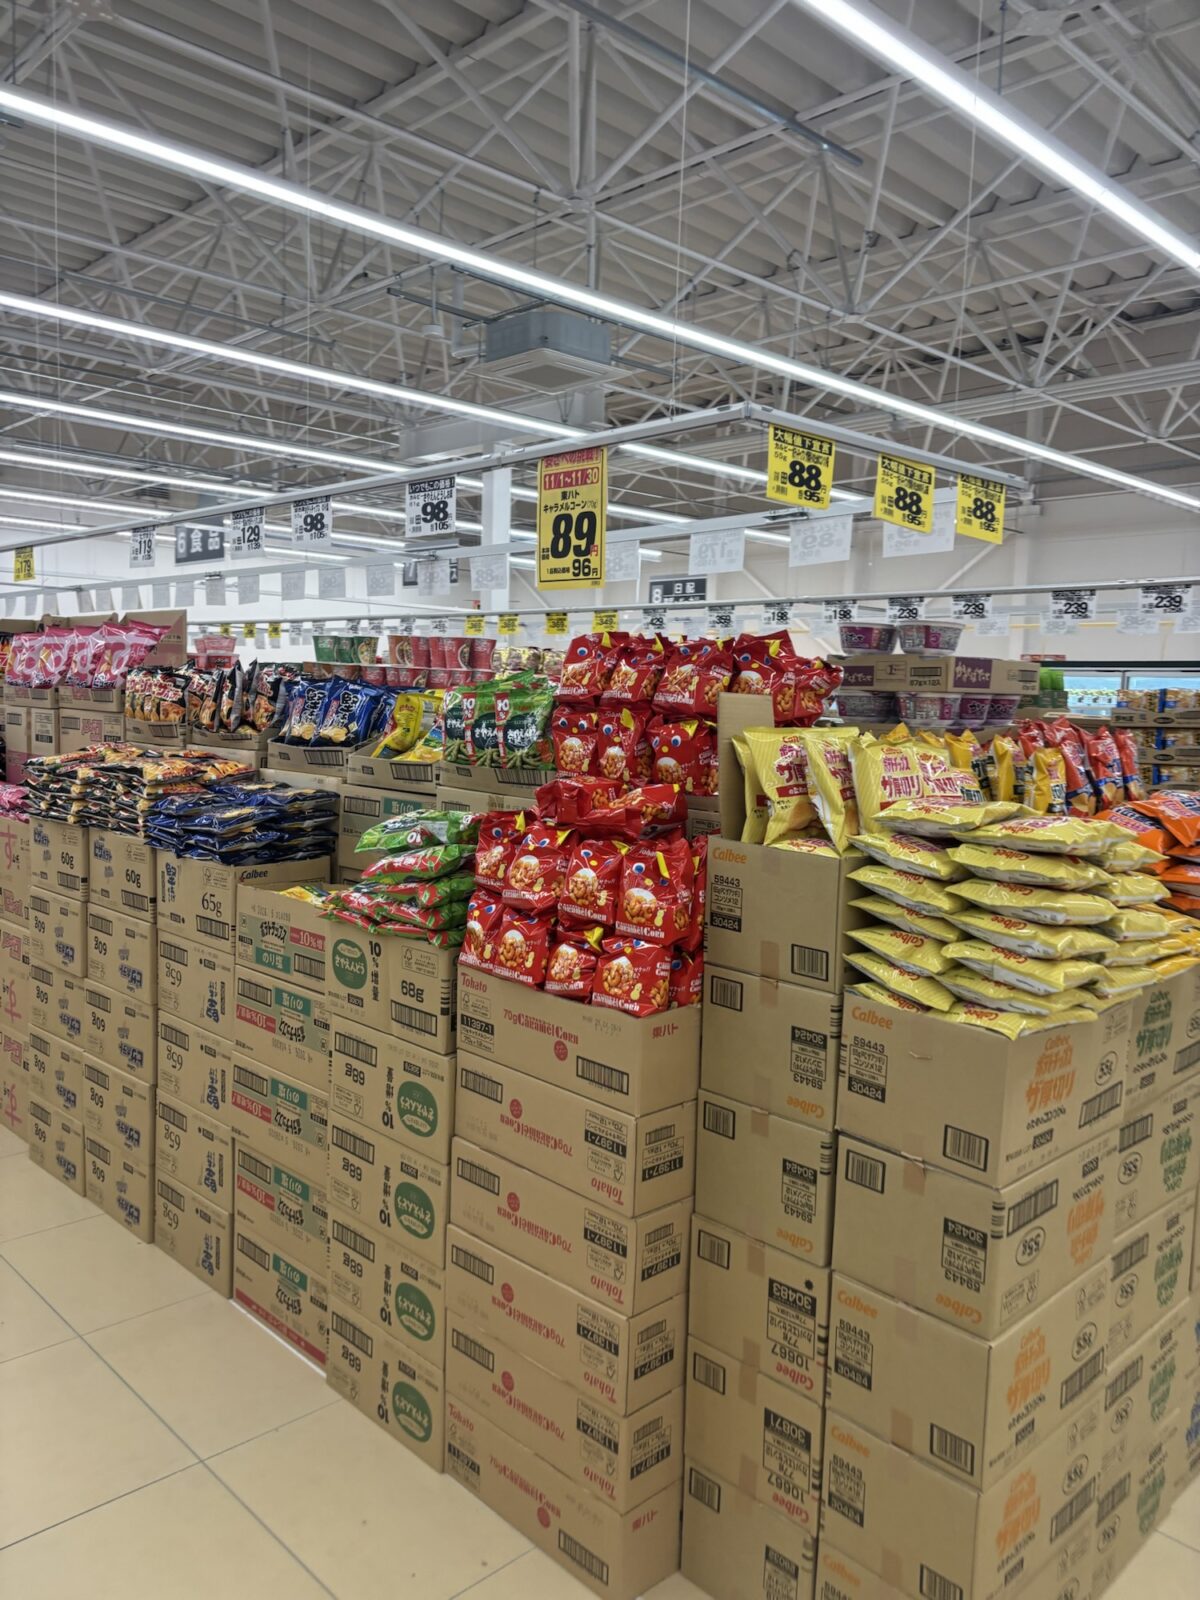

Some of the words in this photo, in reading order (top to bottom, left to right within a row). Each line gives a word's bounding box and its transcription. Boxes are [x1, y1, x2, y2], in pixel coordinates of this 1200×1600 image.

[788, 460, 821, 491] 88
[561, 489, 580, 501] 東ハト
[804, 490, 820, 502] 95
[895, 487, 922, 516] 88
[421, 500, 449, 523] 98
[972, 498, 995, 523] 88
[303, 513, 325, 533] 98
[241, 525, 260, 544] 129
[550, 511, 597, 559] 89
[572, 558, 591, 577] 96
[652, 588, 662, 604] 8
[1155, 595, 1182, 608] 239
[898, 607, 918, 619] 239
[963, 602, 984, 615] 239
[1064, 602, 1088, 614] 239
[463, 698, 475, 709] 10
[497, 699, 509, 711] 10
[61, 851, 75, 870] 60g
[712, 847, 747, 864] Calbee
[125, 868, 142, 888] 60g
[240, 869, 268, 882] Calbee
[713, 874, 741, 888] 59443
[201, 891, 223, 919] 65g
[34, 915, 46, 934] 60g
[712, 916, 739, 931] 30424
[991, 914, 1028, 931] Calbee
[93, 936, 108, 957] 60g
[890, 930, 925, 948] Calbee
[262, 953, 284, 970] のり塩
[334, 953, 365, 976] さやえんどう
[165, 963, 182, 987] 65g
[461, 972, 488, 993] Tohato
[35, 986, 49, 1005] 60g
[282, 992, 304, 1010] のり塩
[400, 980, 424, 1003] 68g
[91, 1011, 106, 1032] 60g
[851, 1005, 893, 1030] Calbee
[652, 1023, 679, 1039] 東ハト
[793, 1028, 824, 1044] 30424
[853, 1035, 885, 1054] 59443
[167, 1045, 183, 1071] 65g
[345, 1063, 365, 1086] 68g
[793, 1072, 823, 1090] 59443
[90, 1087, 104, 1109] 60g
[850, 1080, 883, 1100] 30424
[400, 1095, 434, 1122] さやえんどう
[787, 1095, 825, 1120] Calbee
[164, 1124, 181, 1151] 65g
[342, 1156, 363, 1182] 68g
[785, 1161, 814, 1179] 30424
[591, 1176, 624, 1206] Tohato
[784, 1204, 812, 1224] 59443
[776, 1227, 813, 1253] Calbee
[947, 1221, 984, 1244] 30424
[590, 1273, 624, 1305] Tohato
[944, 1269, 981, 1293] 59443
[837, 1289, 879, 1319] Calbee
[935, 1293, 982, 1325] Calbee
[775, 1362, 814, 1391] Calbee
[584, 1371, 617, 1404] Tohato
[448, 1403, 474, 1432] Tohato
[831, 1425, 870, 1457] Calbee
[583, 1466, 617, 1500] Tohato
[772, 1493, 809, 1524] Calbee
